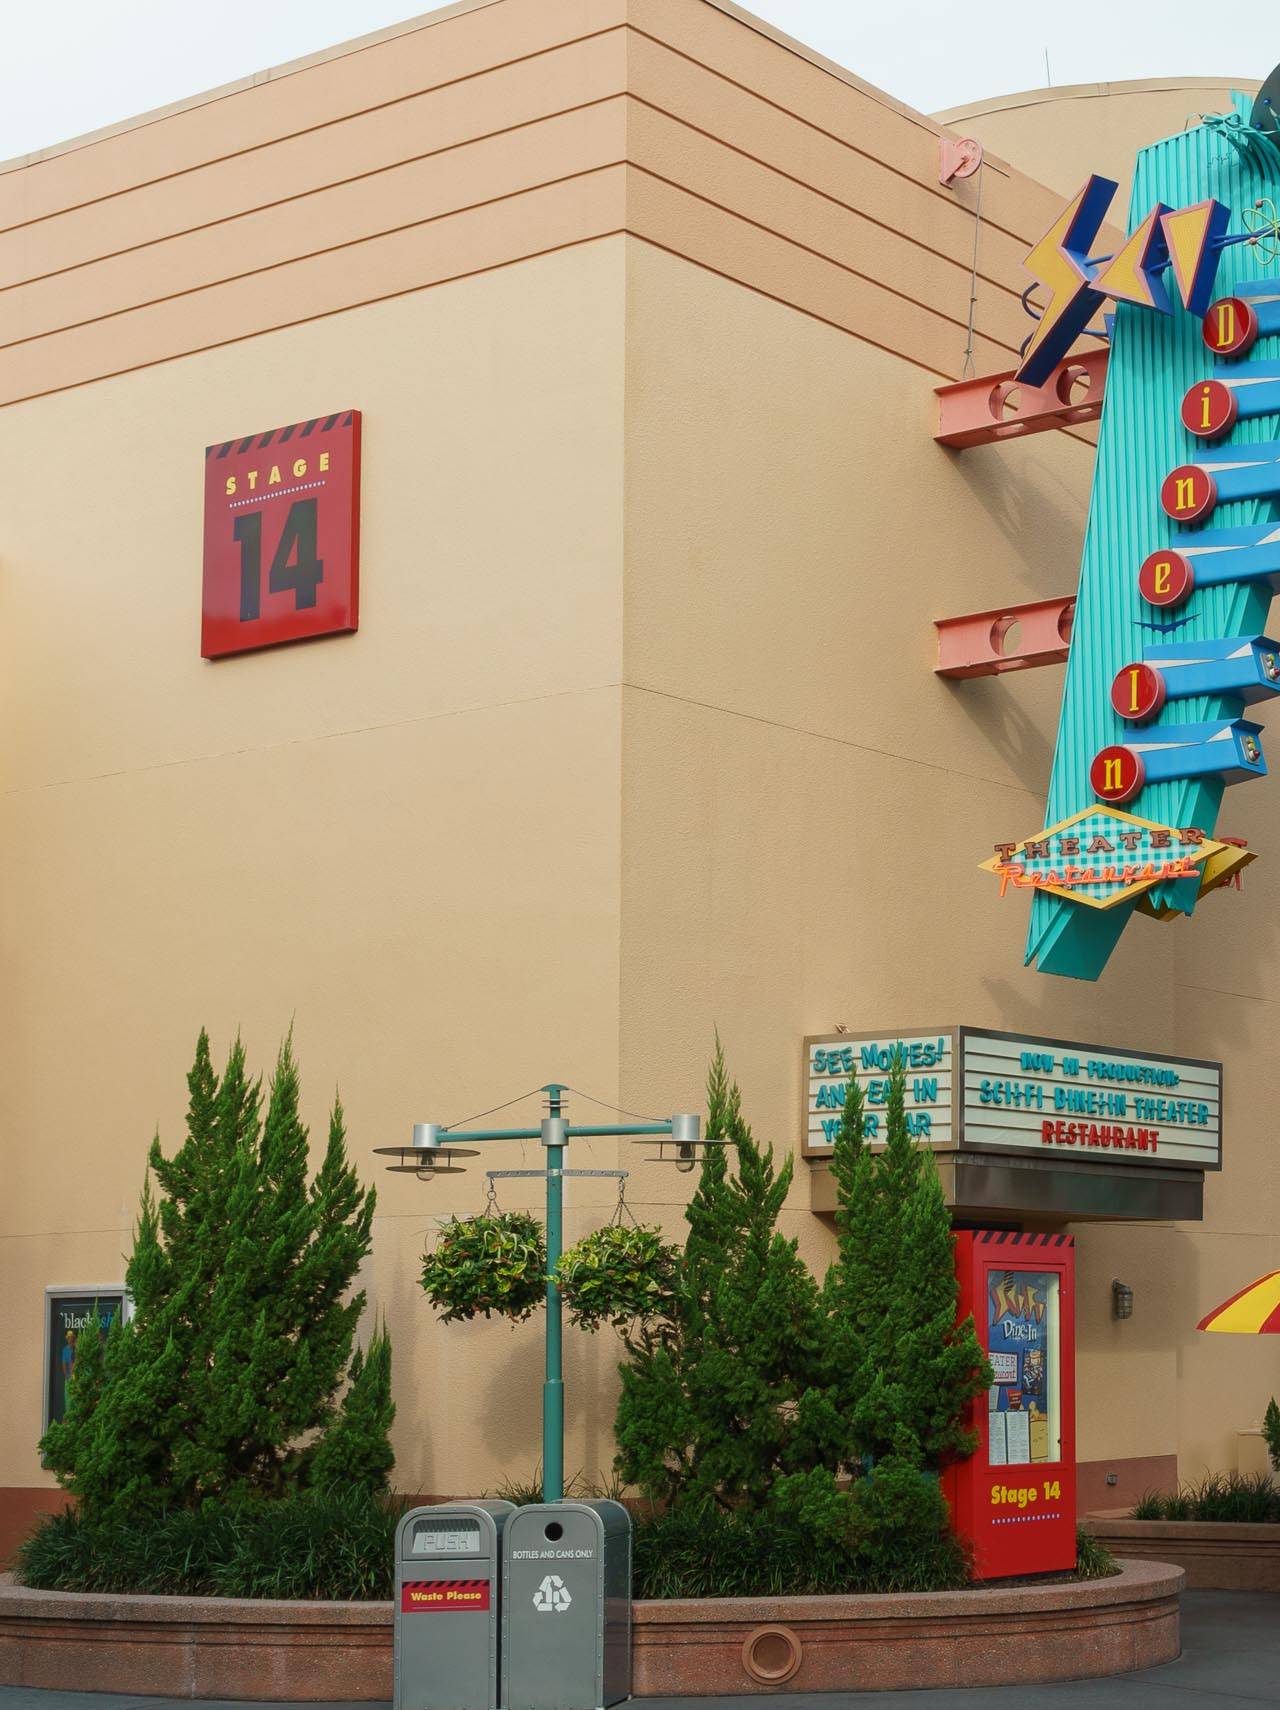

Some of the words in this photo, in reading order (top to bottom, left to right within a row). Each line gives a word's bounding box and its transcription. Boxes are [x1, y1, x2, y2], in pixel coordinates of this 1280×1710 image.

[225, 452, 330, 496] STAGE
[233, 497, 324, 623] 14
[994, 827, 1206, 862] THEATER
[992, 857, 1200, 897] Restaurant
[813, 1046, 853, 1075] SEE
[1020, 1052, 1054, 1074] NOW
[1062, 1057, 1080, 1076] IN
[815, 1082, 850, 1109] AN
[913, 1077, 937, 1103] IN
[979, 1078, 1043, 1109] SCI-FI
[1054, 1086, 1127, 1117] DINE-IN
[1134, 1096, 1209, 1126] THEATER
[1041, 1120, 1160, 1153] RESTAURANT
[1003, 1319, 1037, 1342] Dine-In
[991, 1485, 1037, 1508] Stage
[1043, 1481, 1061, 1500] 14
[512, 1550, 539, 1559] BOTTLES
[540, 1550, 555, 1559] AND
[556, 1549, 574, 1559] CANS
[575, 1549, 593, 1558] ONLY
[411, 1592, 443, 1601] Waste
[447, 1590, 481, 1600] Please
